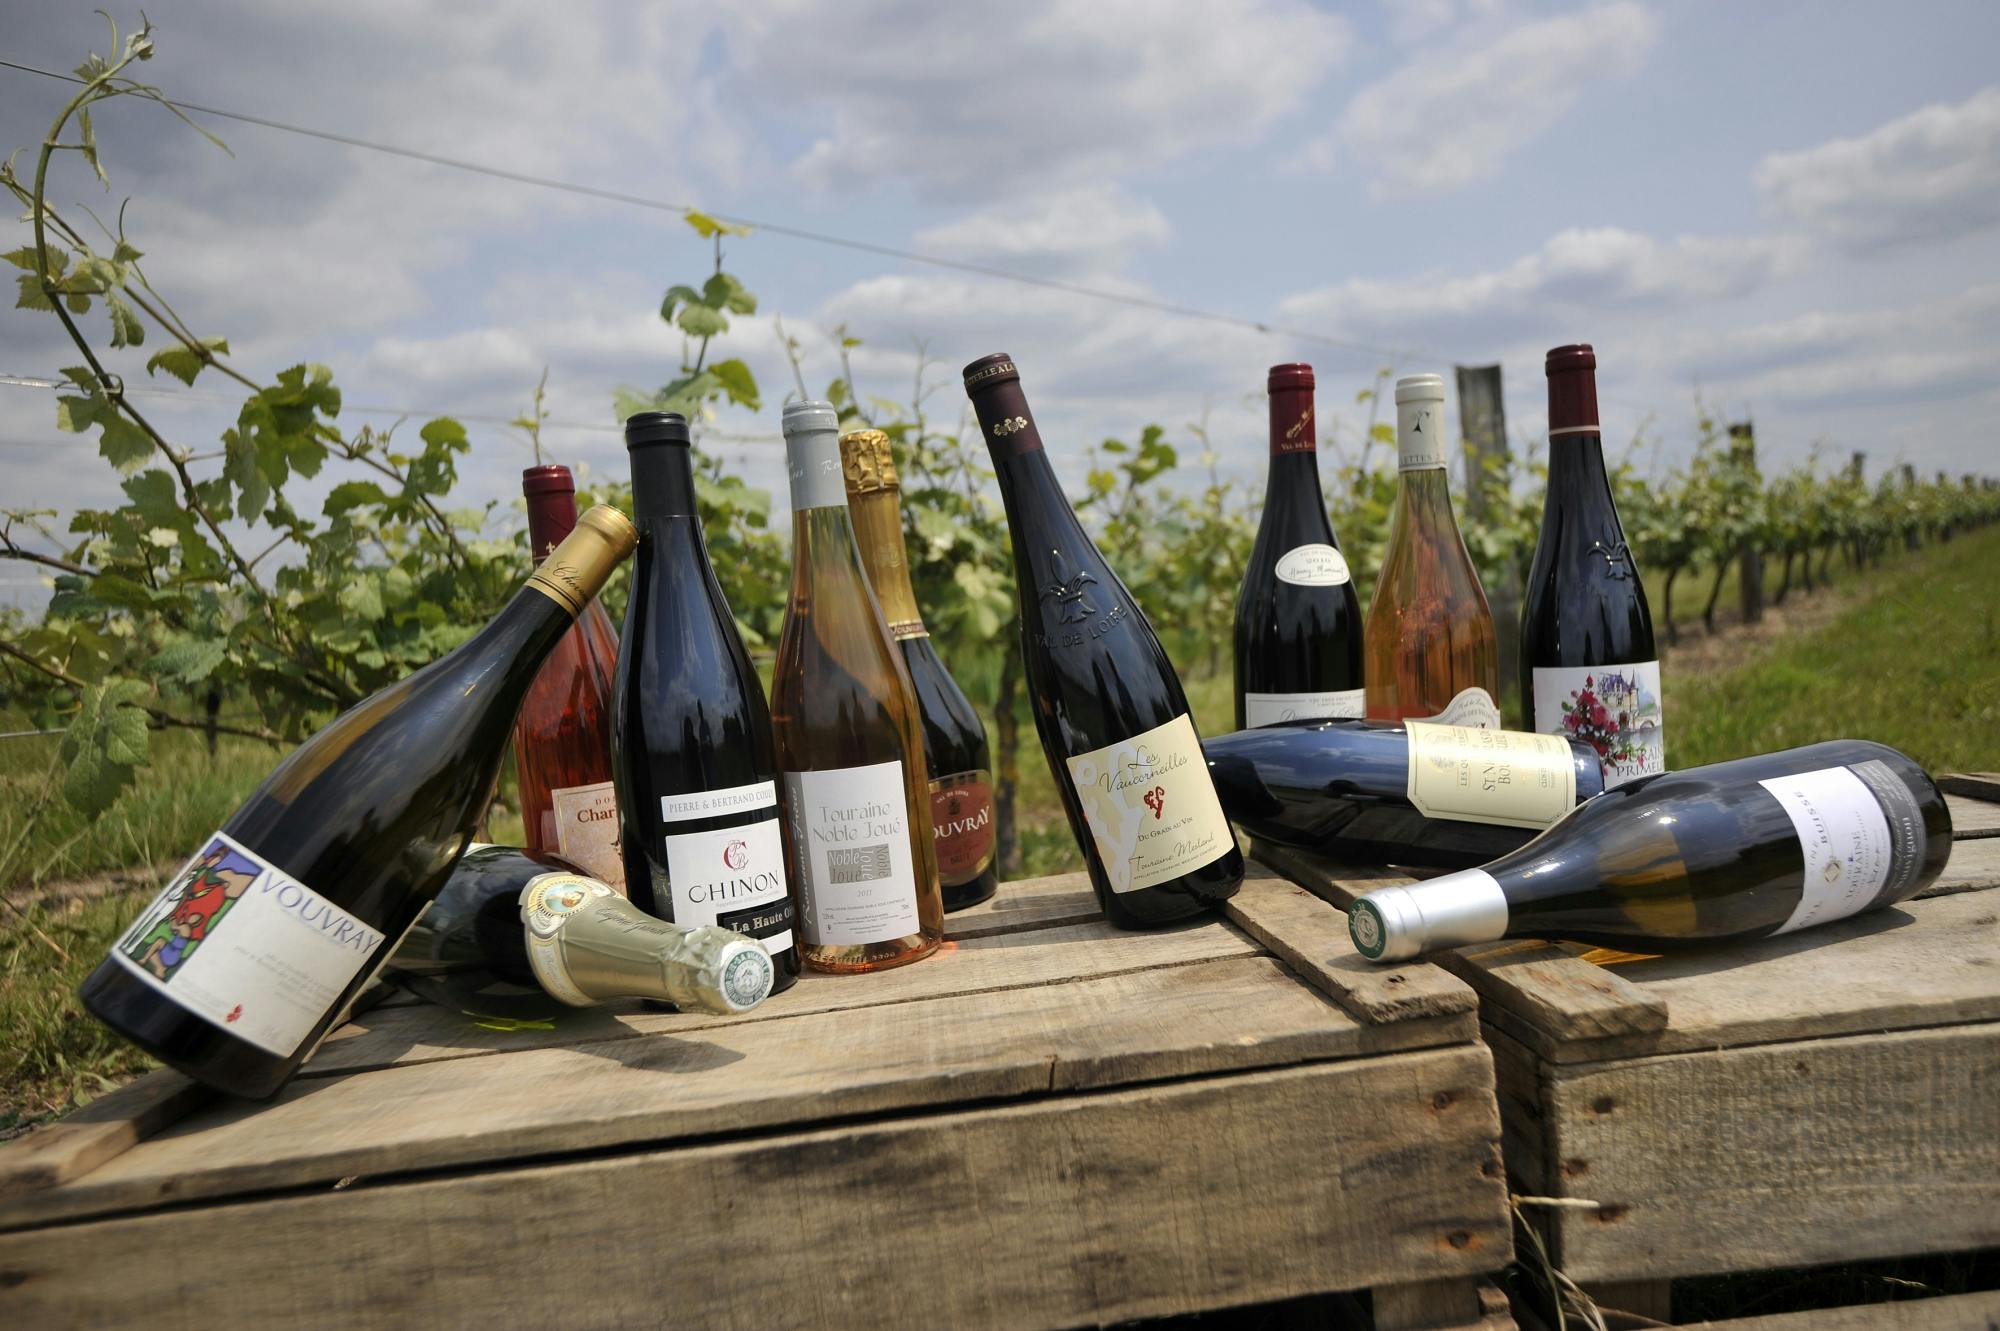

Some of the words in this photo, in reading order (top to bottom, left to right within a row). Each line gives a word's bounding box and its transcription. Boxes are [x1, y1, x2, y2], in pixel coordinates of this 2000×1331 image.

[1127, 744, 1161, 769] Les
[1099, 752, 1188, 793] Vaucorneilles
[669, 801, 700, 814] PIERRE
[702, 799, 710, 809] &
[712, 790, 755, 808] BERTRAND
[819, 801, 892, 823] Touraine
[576, 808, 616, 823] Char
[812, 824, 859, 842] Noble
[864, 817, 902, 839] Joué
[828, 847, 861, 866] Noble
[1128, 855, 1174, 873] Touraine
[1173, 831, 1215, 857] Mesland
[1895, 816, 1917, 890] Sauvignon
[688, 870, 780, 903] CHINON
[259, 870, 383, 955] VOUVRAY
[732, 922, 750, 934] La
[752, 913, 784, 929] Haute
